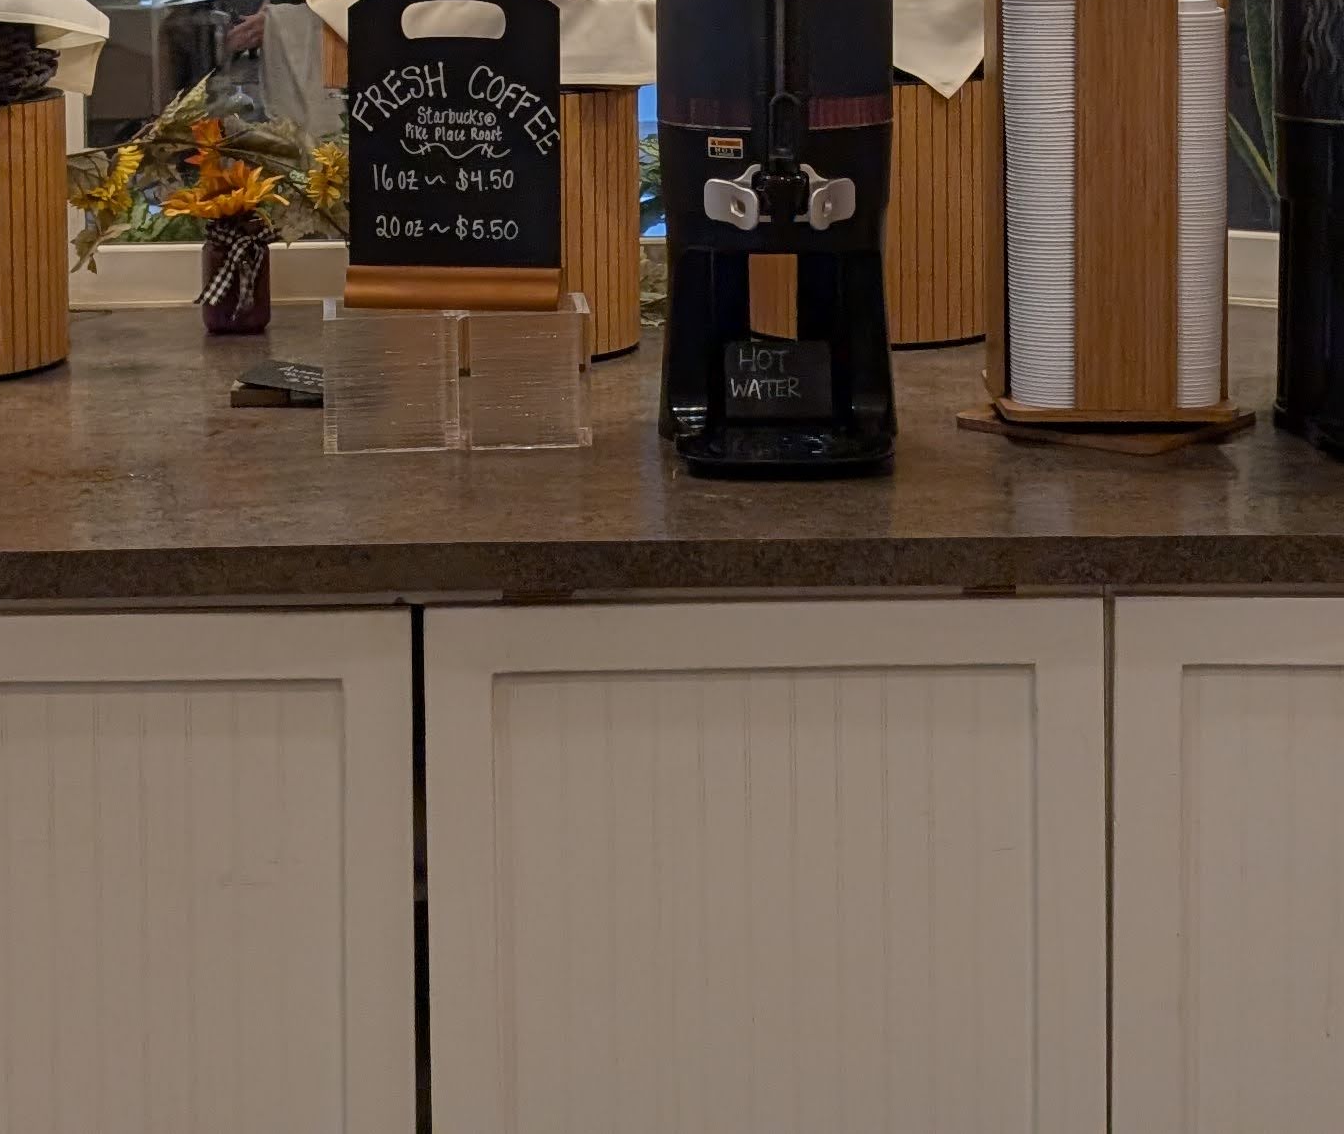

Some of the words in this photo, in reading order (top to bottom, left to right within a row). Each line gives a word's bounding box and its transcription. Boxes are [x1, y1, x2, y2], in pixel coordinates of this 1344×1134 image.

[351, 61, 448, 132] FRESH
[468, 65, 560, 155] COFFEE
[405, 122, 429, 140] Pike
[434, 124, 466, 141] Place
[470, 123, 503, 141] Roast
[456, 168, 514, 192] $4.50
[455, 215, 519, 240] $5.50
[739, 346, 789, 373] HOT
[730, 377, 801, 400] WATER
